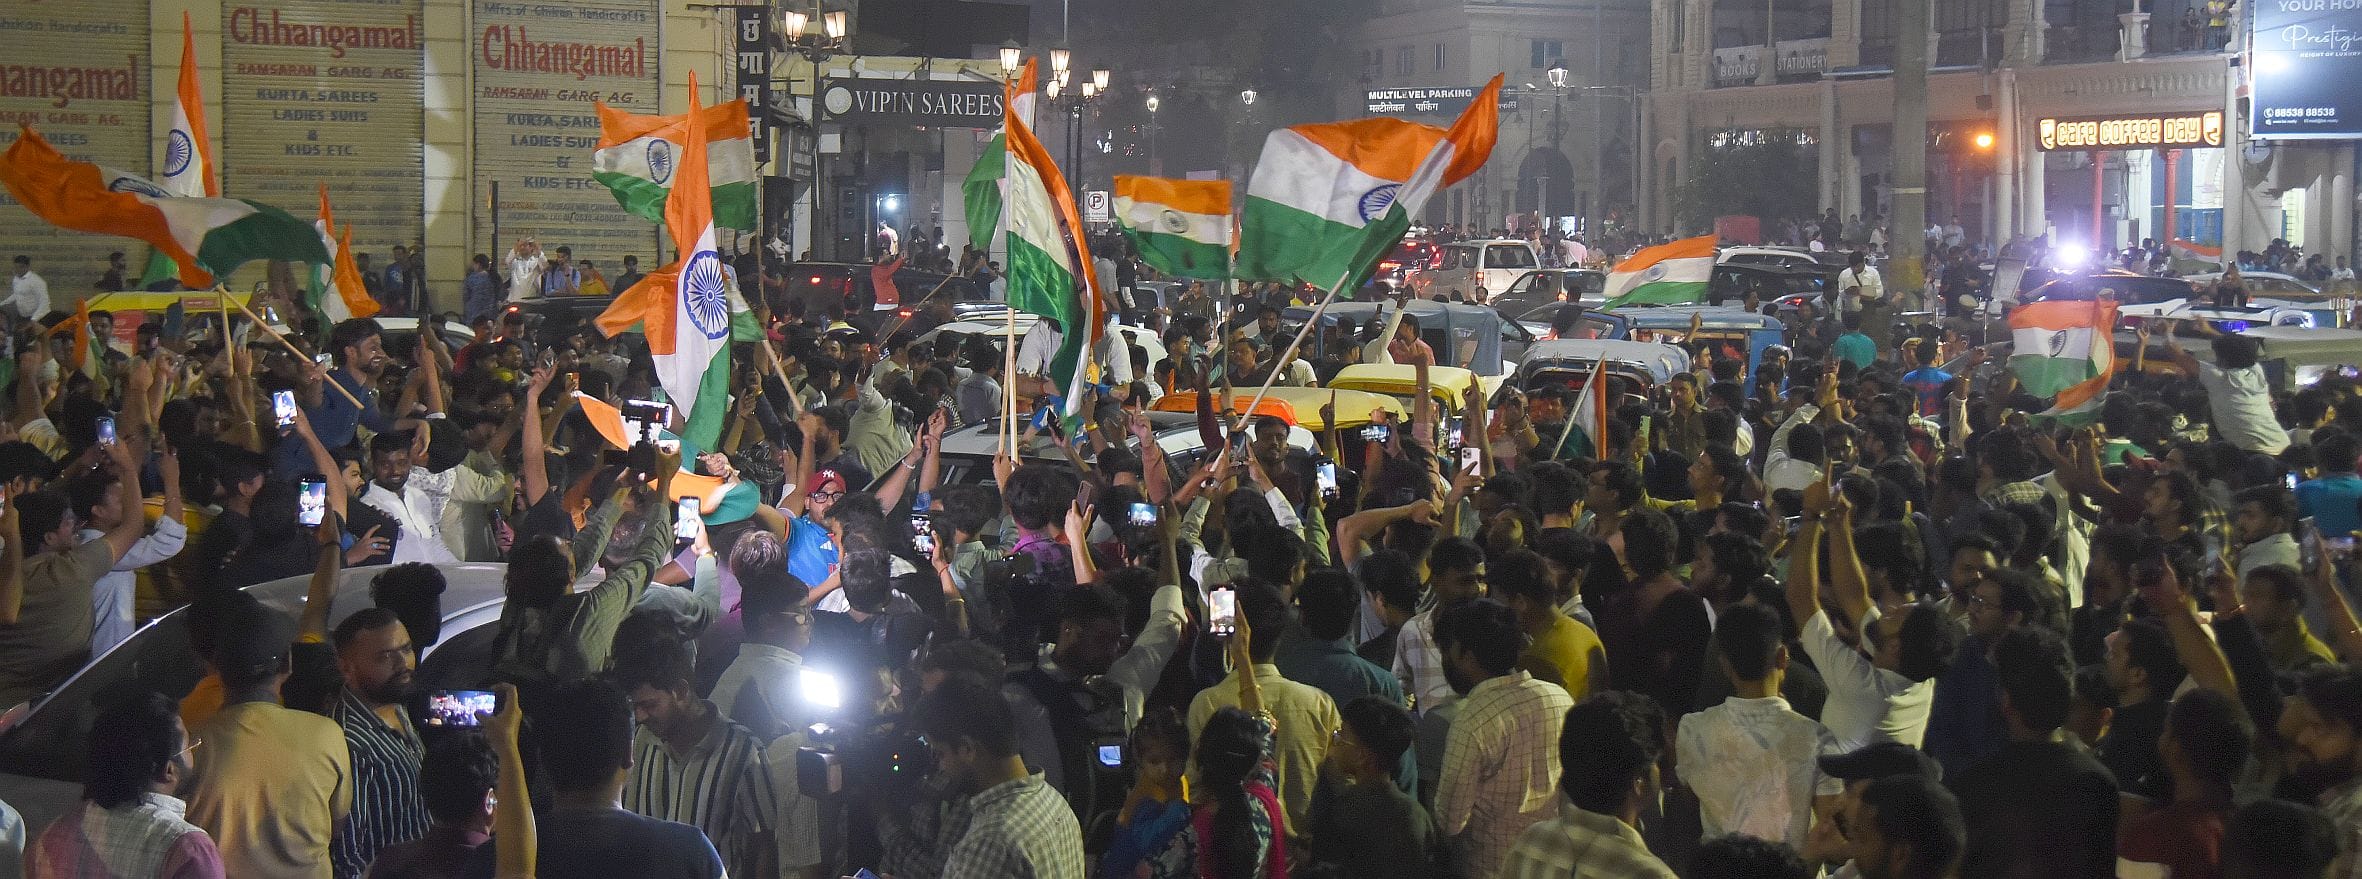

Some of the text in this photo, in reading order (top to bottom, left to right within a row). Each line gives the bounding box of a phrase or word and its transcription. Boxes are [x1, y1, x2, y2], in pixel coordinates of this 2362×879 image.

[230, 7, 415, 59] Chhangamal
[483, 24, 645, 81] Chhangamal
[236, 63, 316, 76] RAMSARAN
[327, 66, 372, 78] GARG
[1720, 64, 1756, 77] BOOKS
[1777, 55, 1828, 71] STATIONERY
[483, 86, 549, 100] RAMSARAN
[556, 89, 600, 102] GARG
[1368, 89, 1472, 100] MULTILEVEL PARKING
[855, 90, 1003, 117] VIPIN SAREES
[273, 109, 369, 123] LADIES SUITS
[2275, 107, 2335, 118] 88538 88538
[511, 133, 562, 148] LADIES
[285, 143, 320, 156] KIDS
[525, 175, 560, 189] KIDS
